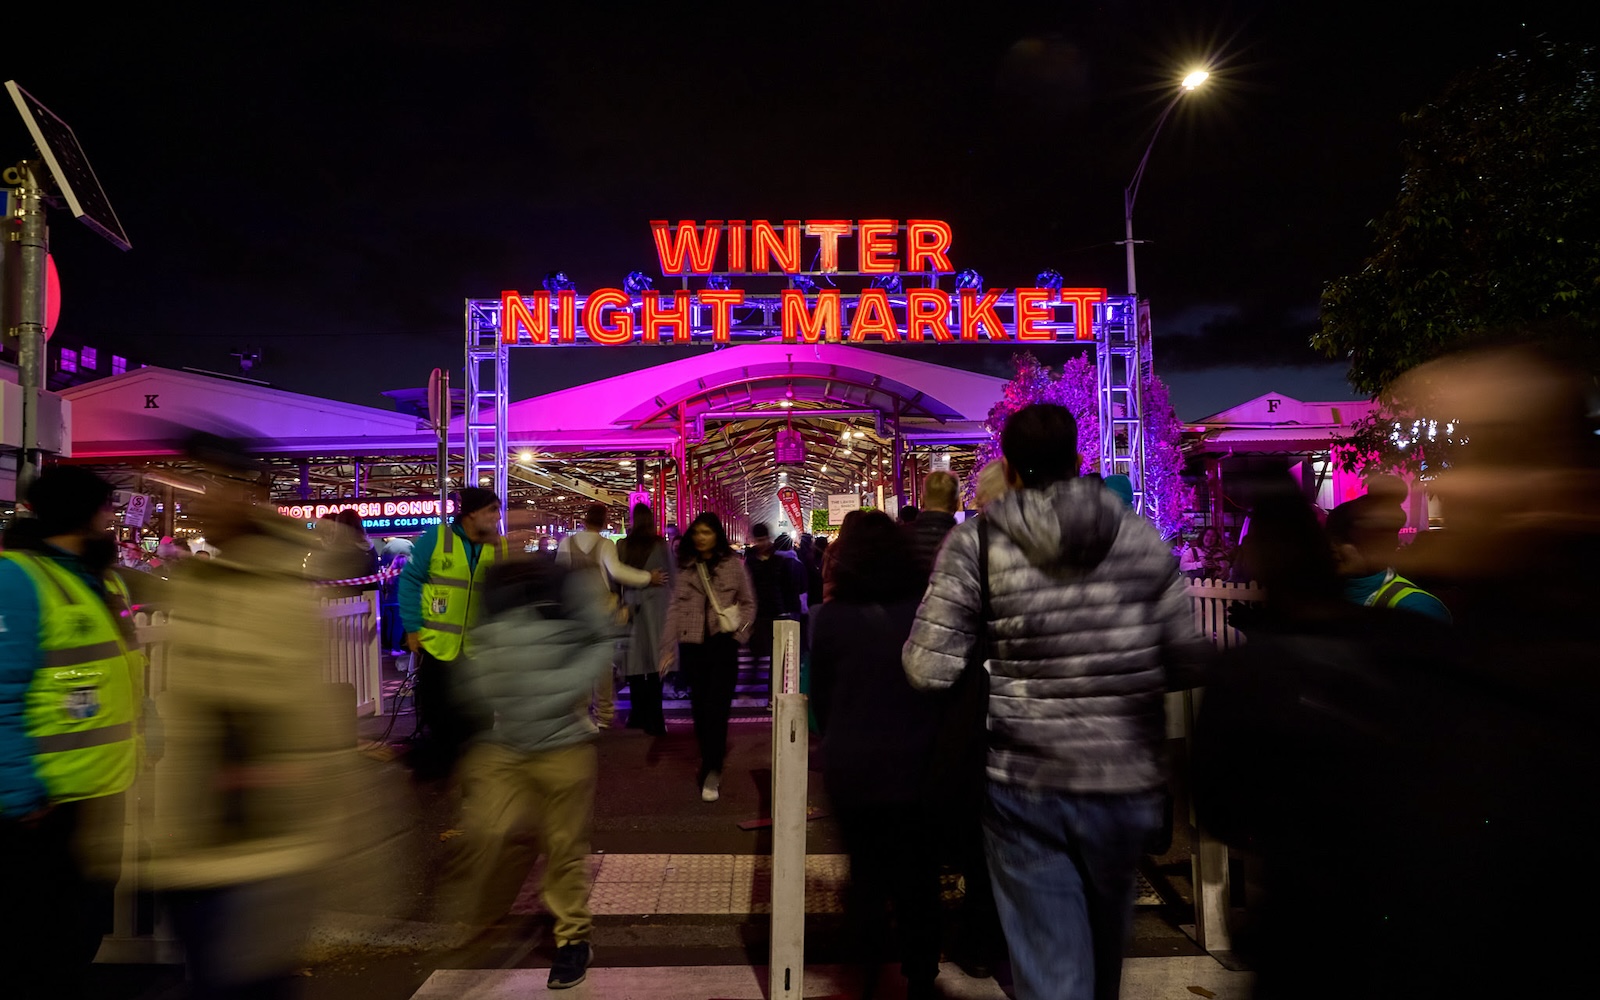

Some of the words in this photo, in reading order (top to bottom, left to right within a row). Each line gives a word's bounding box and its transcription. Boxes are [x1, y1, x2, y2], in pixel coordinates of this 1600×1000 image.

[649, 219, 955, 275] WINTER
[501, 287, 745, 346] NIGHT
[781, 287, 1107, 344] MARKET
[144, 394, 160, 409] K
[1266, 399, 1281, 413] F
[277, 505, 314, 519] HOT
[384, 499, 455, 516] DONUTS
[394, 517, 419, 526] COLD
[420, 516, 455, 526] DRINS
